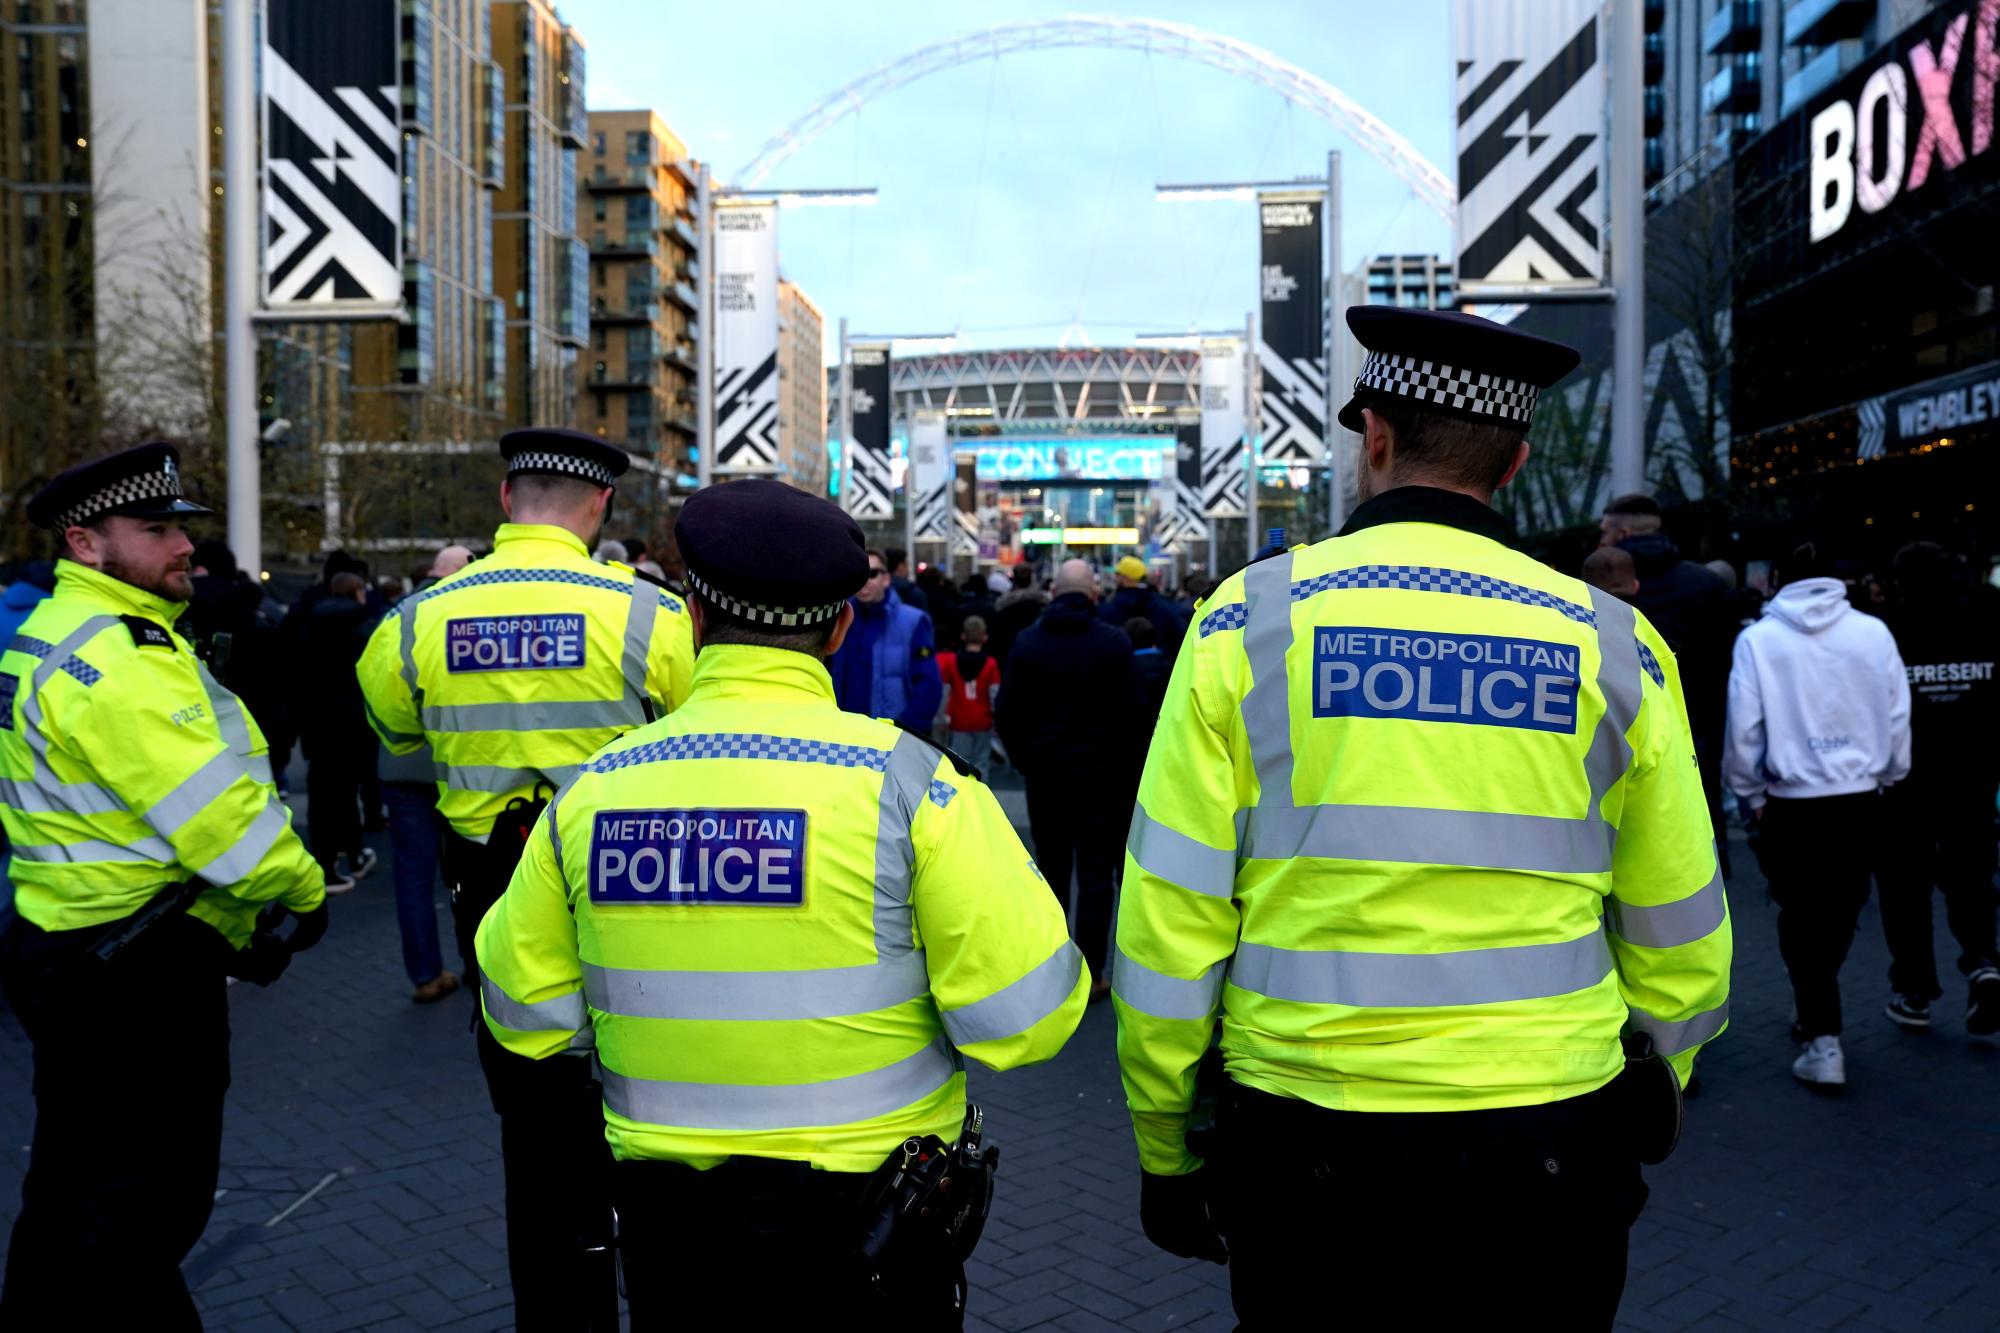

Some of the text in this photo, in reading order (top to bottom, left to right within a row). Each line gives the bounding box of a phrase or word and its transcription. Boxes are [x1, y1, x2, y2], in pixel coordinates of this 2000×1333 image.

[1898, 379, 2000, 438] WEMBLEY
[452, 618, 578, 637] METROPOLITAN
[452, 635, 578, 667] POLICE
[1319, 633, 1575, 672] METROPOLITAN
[1905, 662, 1995, 684] EPRESENT
[1319, 661, 1575, 725] POLICE
[600, 818, 795, 842] METROPOLITAN
[598, 847, 792, 894] POLICE
